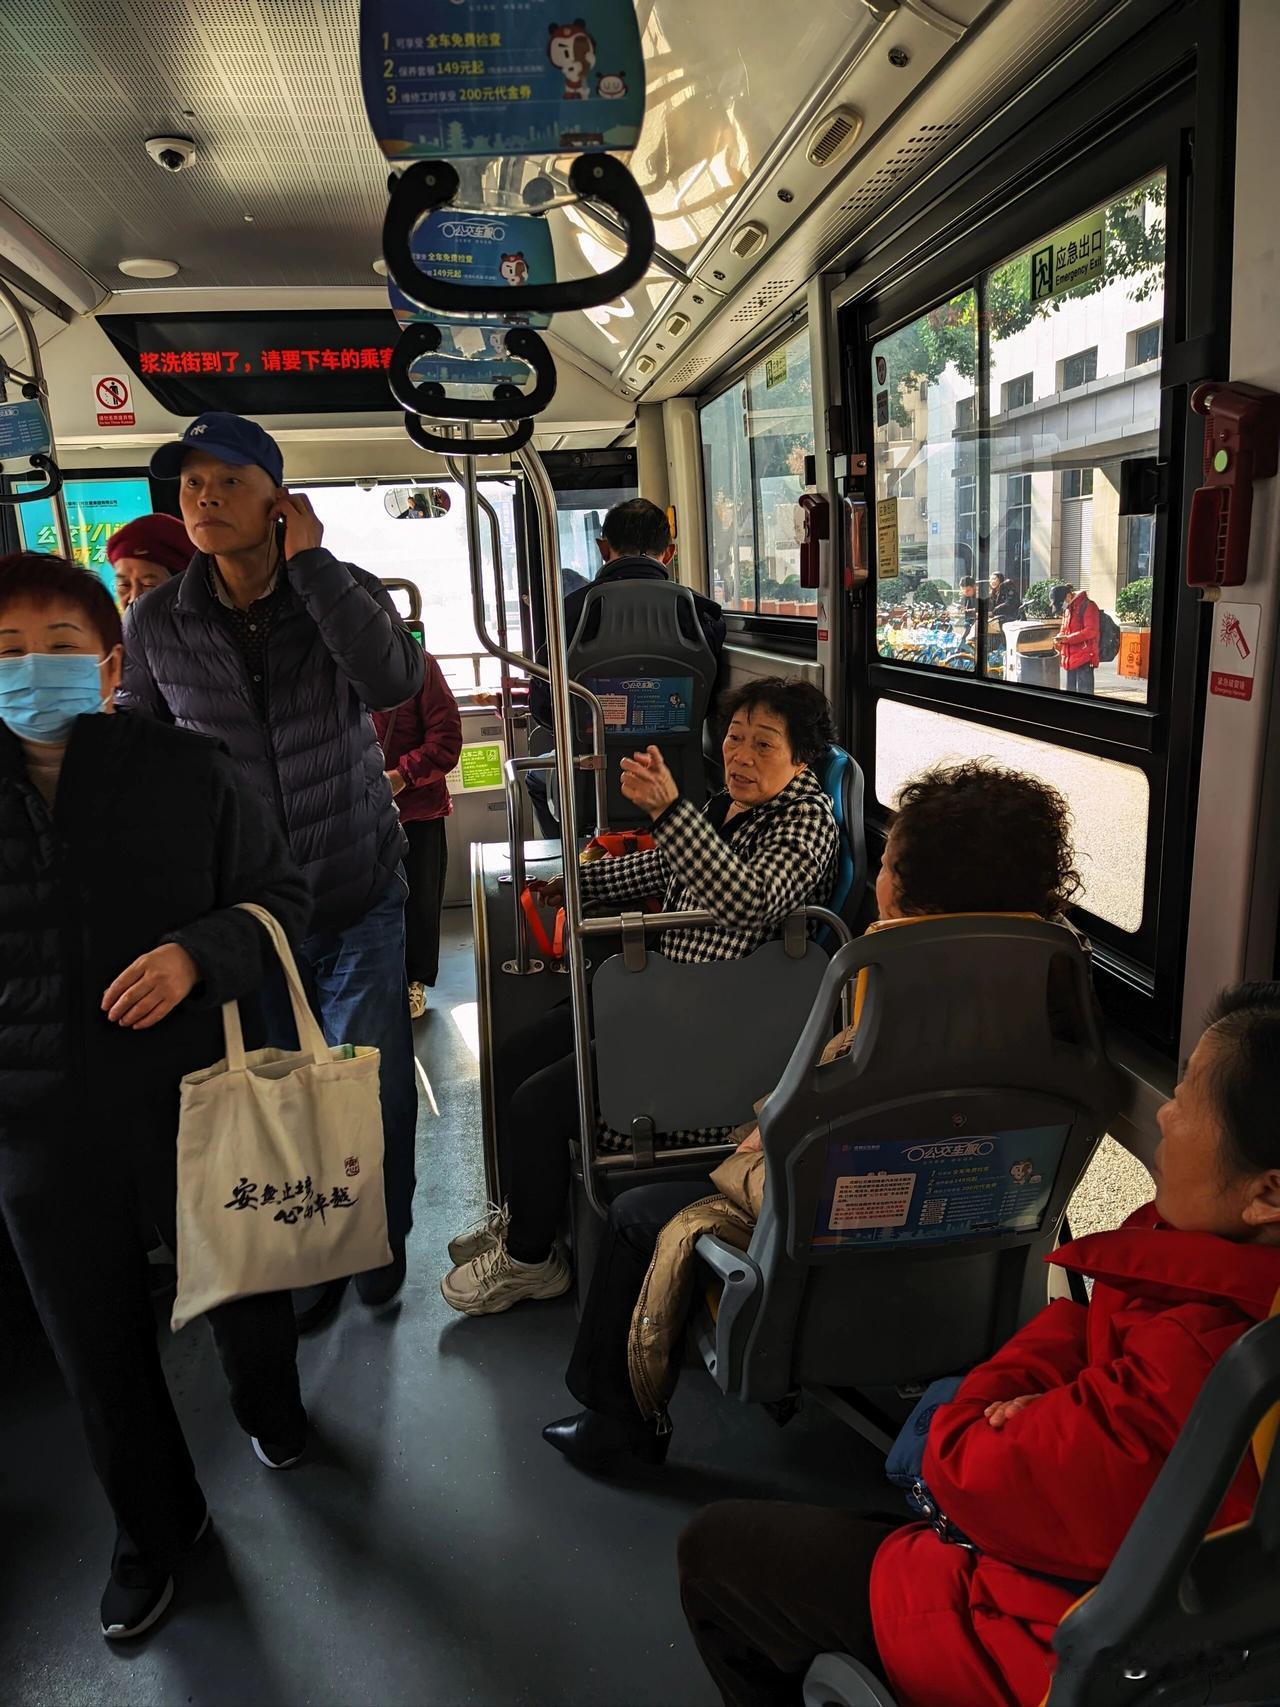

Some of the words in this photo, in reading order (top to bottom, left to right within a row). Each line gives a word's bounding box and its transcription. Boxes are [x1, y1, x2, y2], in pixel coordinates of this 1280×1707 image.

[1056, 230, 1102, 272] 应急出口
[1055, 264, 1088, 286] Emergency
[1089, 256, 1102, 270] Exit
